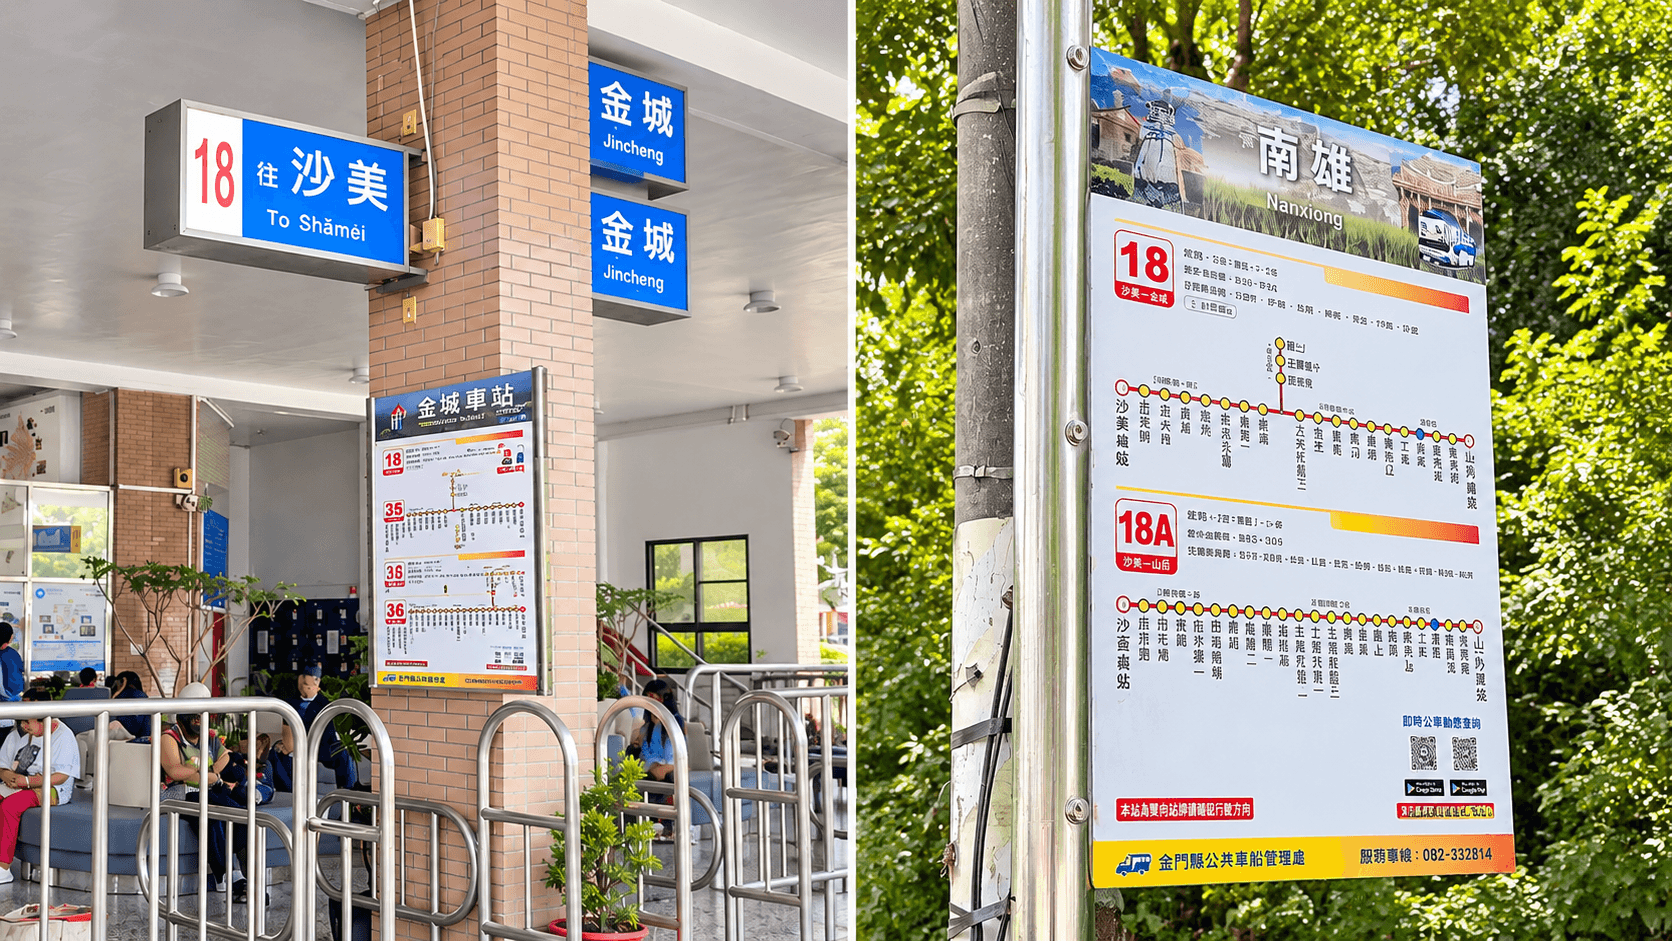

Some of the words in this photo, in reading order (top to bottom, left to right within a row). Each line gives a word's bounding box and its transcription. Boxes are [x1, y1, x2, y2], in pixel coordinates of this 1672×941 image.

[600, 80, 674, 138] 金城
[603, 133, 664, 167] Jincheng
[1257, 124, 1354, 194] 南雄
[194, 137, 235, 208] 18
[266, 208, 290, 228] To
[1266, 191, 1343, 231] Nanxiong
[601, 210, 675, 264] 金城
[603, 264, 664, 294] Jincheng
[1120, 240, 1169, 284] 18
[417, 382, 515, 420] 金城車站
[385, 452, 402, 468] 18
[385, 502, 403, 517] 35
[1118, 509, 1175, 548] 18A
[386, 565, 403, 580] 36
[386, 603, 405, 618] 36
[1158, 849, 1305, 871] 金門縣公共車船管理處
